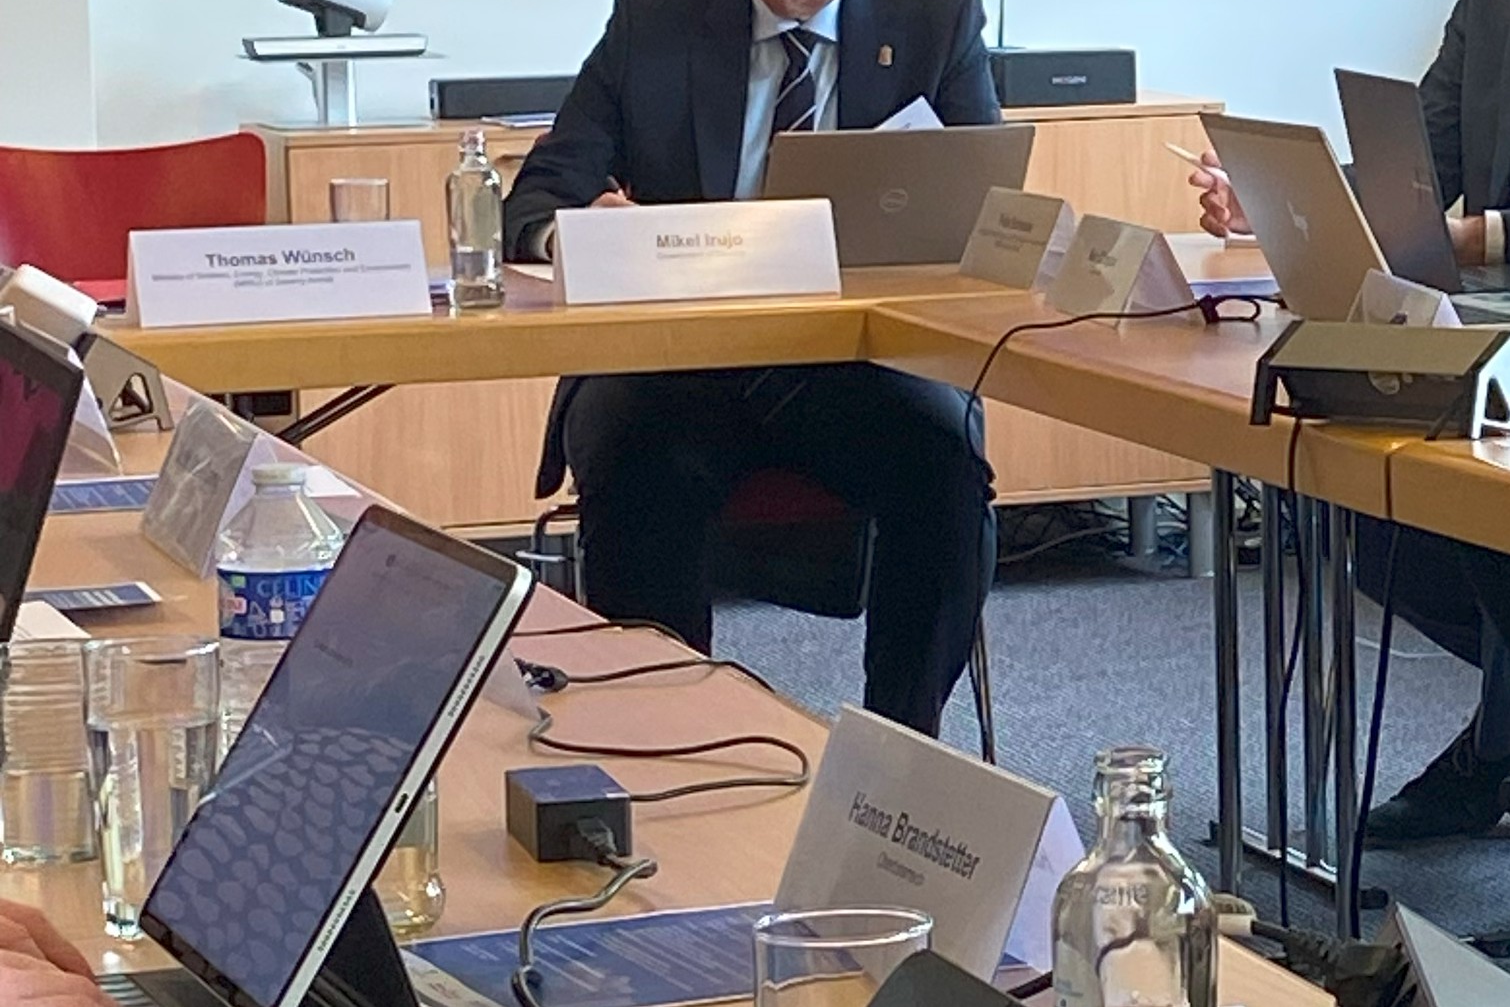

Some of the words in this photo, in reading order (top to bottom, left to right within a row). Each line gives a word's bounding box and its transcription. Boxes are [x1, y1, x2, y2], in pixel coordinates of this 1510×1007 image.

[656, 233, 701, 248] Mikel
[205, 252, 278, 268] Thomas
[281, 248, 356, 265] Wünsch
[848, 790, 893, 839] Hanna
[891, 811, 980, 880] Brandstetter
